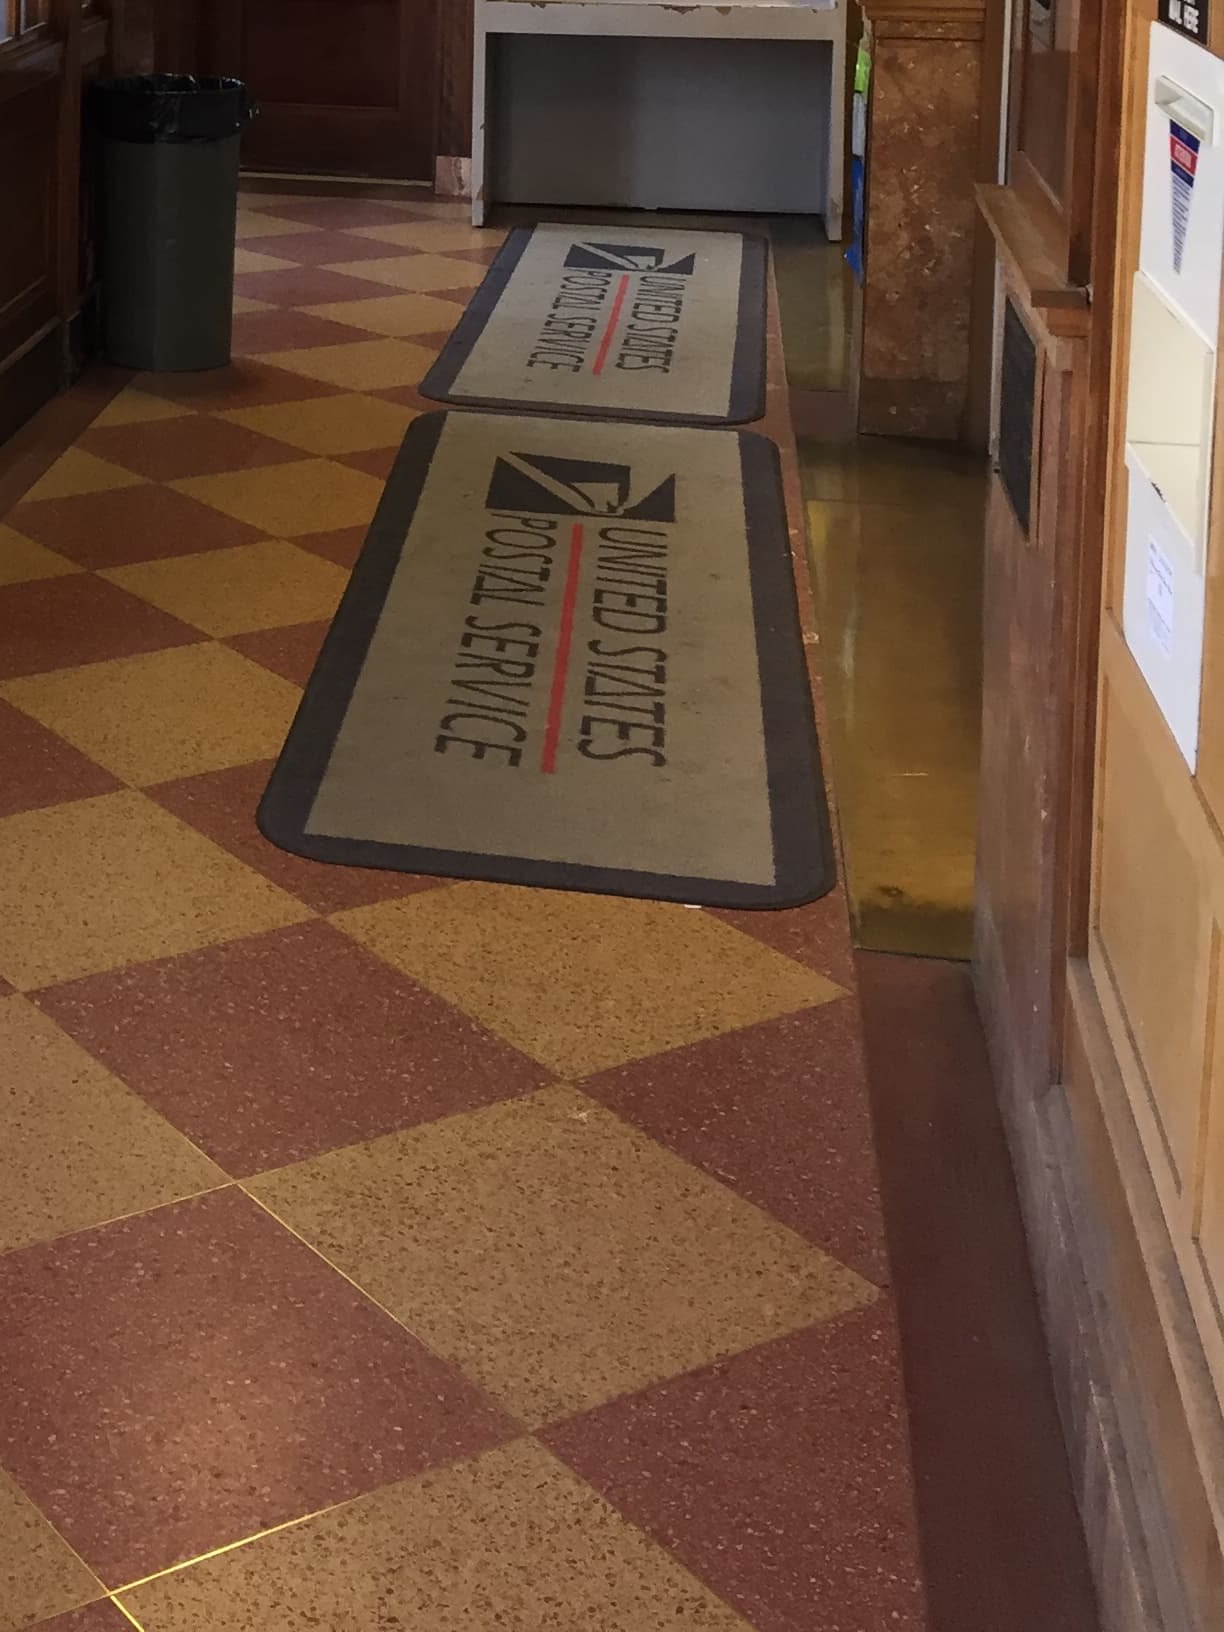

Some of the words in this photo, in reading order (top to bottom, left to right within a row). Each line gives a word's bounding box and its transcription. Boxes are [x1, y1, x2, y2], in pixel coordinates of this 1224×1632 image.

[551, 269, 613, 310] POSTAL
[631, 274, 687, 323] UNITED
[526, 313, 597, 373] SERVICE
[614, 323, 679, 374] STATES
[470, 512, 558, 606] POSTAL
[593, 526, 668, 635] UNITED
[434, 615, 542, 767] SERVICE
[577, 639, 667, 767] STATES
